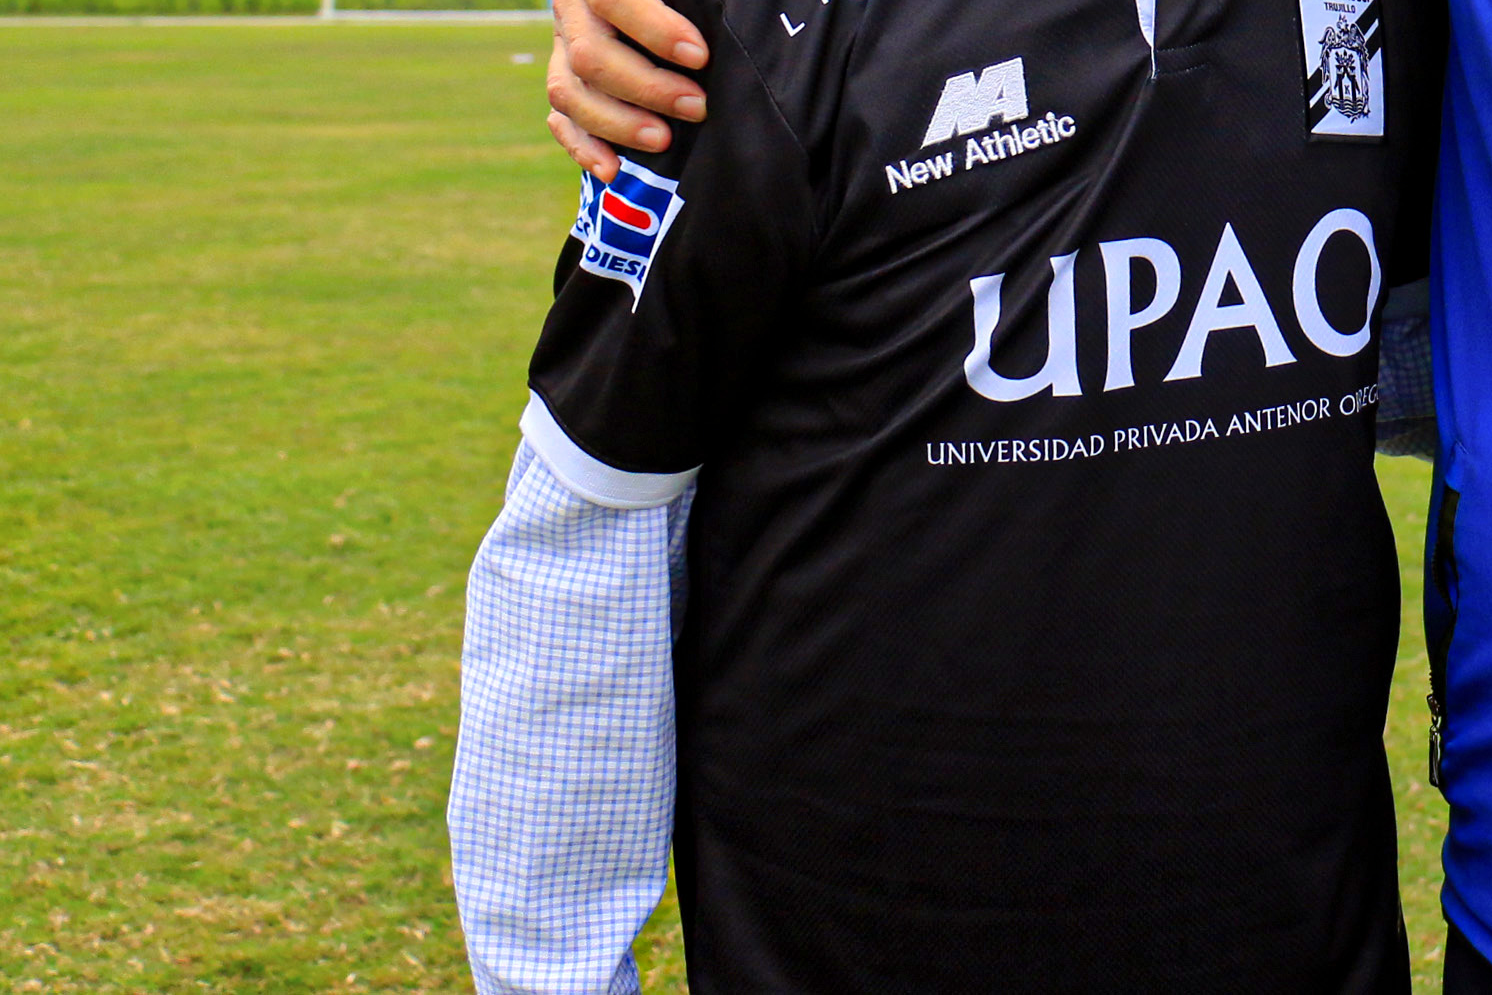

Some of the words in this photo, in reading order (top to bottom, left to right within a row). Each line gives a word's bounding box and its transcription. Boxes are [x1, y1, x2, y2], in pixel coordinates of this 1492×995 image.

[1323, 1, 1356, 14] TRUJILLO
[885, 151, 954, 195] New
[965, 111, 1077, 171] Athletic
[963, 207, 1382, 403] UPAO
[926, 434, 1105, 466] UNIVERSIDAD
[1113, 417, 1219, 453] PRIVADA
[1226, 397, 1331, 436] ANTENOR
[1339, 383, 1379, 416] OREG
